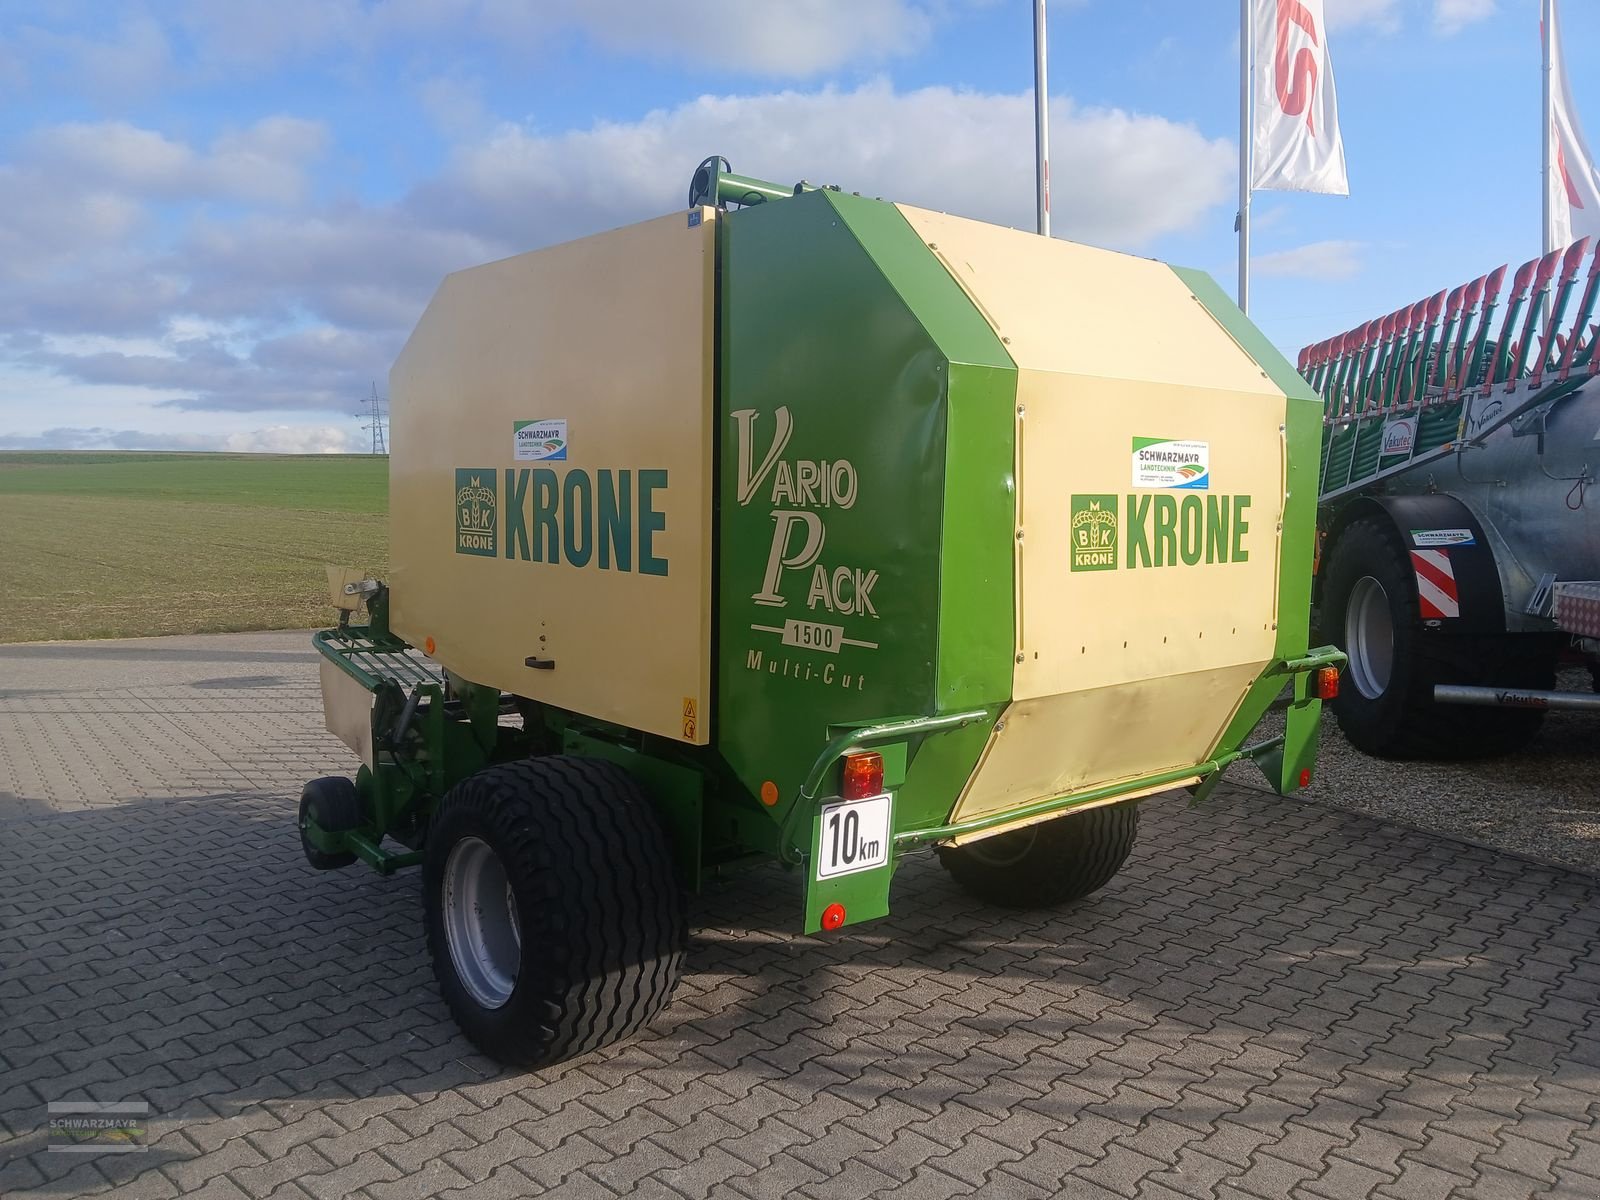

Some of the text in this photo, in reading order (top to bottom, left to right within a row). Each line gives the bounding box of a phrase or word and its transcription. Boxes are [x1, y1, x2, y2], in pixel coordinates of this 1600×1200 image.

[517, 430, 560, 440] SCHWARZMAYR
[1384, 432, 1411, 449] Vakutec
[730, 405, 858, 510] VARIO
[1139, 450, 1200, 463] SCHWARZMAYR
[1140, 464, 1176, 472] LANDTECHNIK
[1089, 500, 1100, 511] M
[505, 468, 669, 577] KRONE
[1126, 494, 1252, 569] KRONE
[460, 534, 493, 550] KRONE
[751, 509, 880, 619] PACK
[1075, 552, 1114, 566] KRONE
[793, 624, 834, 649] 1500
[746, 650, 865, 691] Multi-Cut
[829, 809, 879, 867] 10 km
